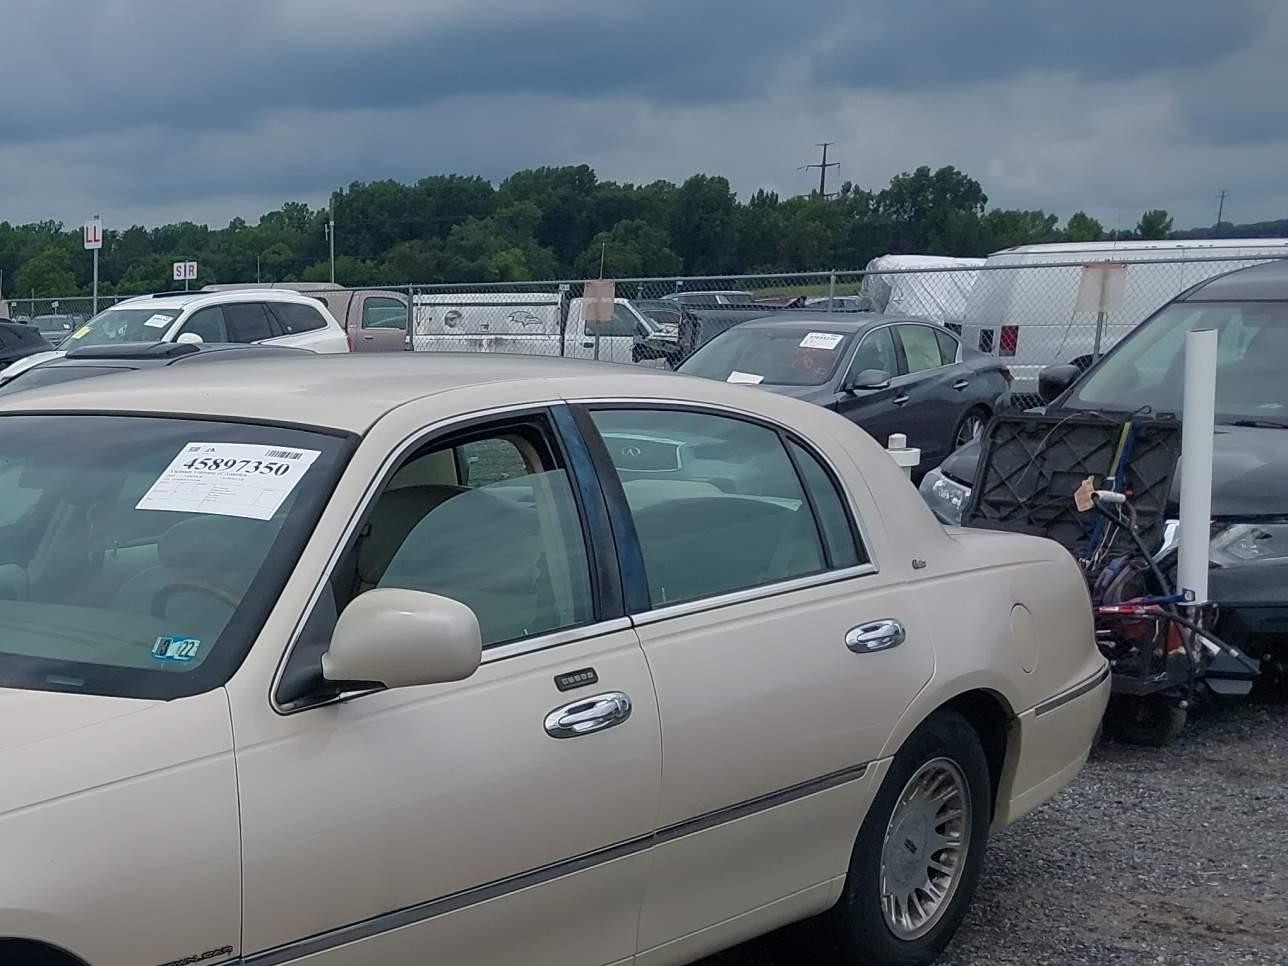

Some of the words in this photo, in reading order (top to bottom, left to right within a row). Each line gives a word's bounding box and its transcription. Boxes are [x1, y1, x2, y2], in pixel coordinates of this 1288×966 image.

[86, 225, 100, 243] LL
[183, 457, 290, 477] 45897350
[178, 641, 195, 657] 22
